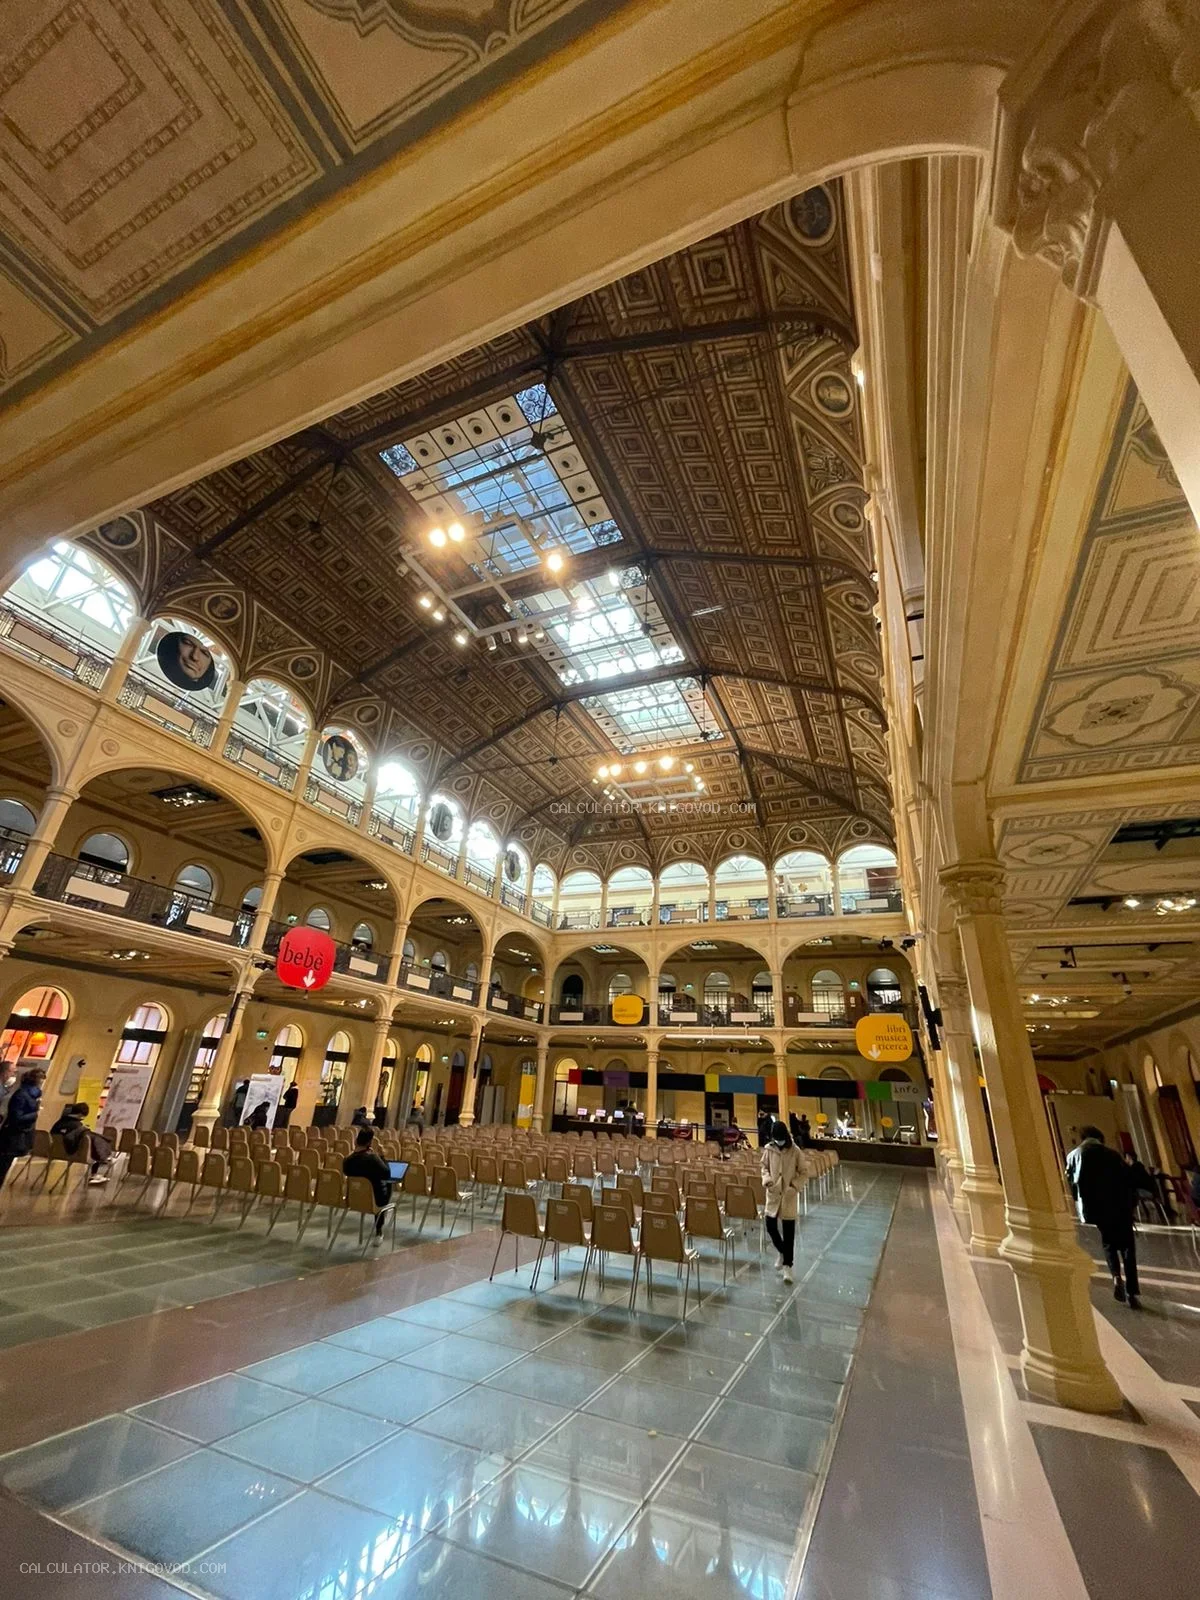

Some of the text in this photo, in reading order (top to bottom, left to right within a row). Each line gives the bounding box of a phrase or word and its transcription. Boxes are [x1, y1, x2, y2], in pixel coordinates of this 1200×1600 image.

[282, 941, 324, 971] bebè
[887, 1024, 906, 1033] libri
[894, 1085, 918, 1094] info
